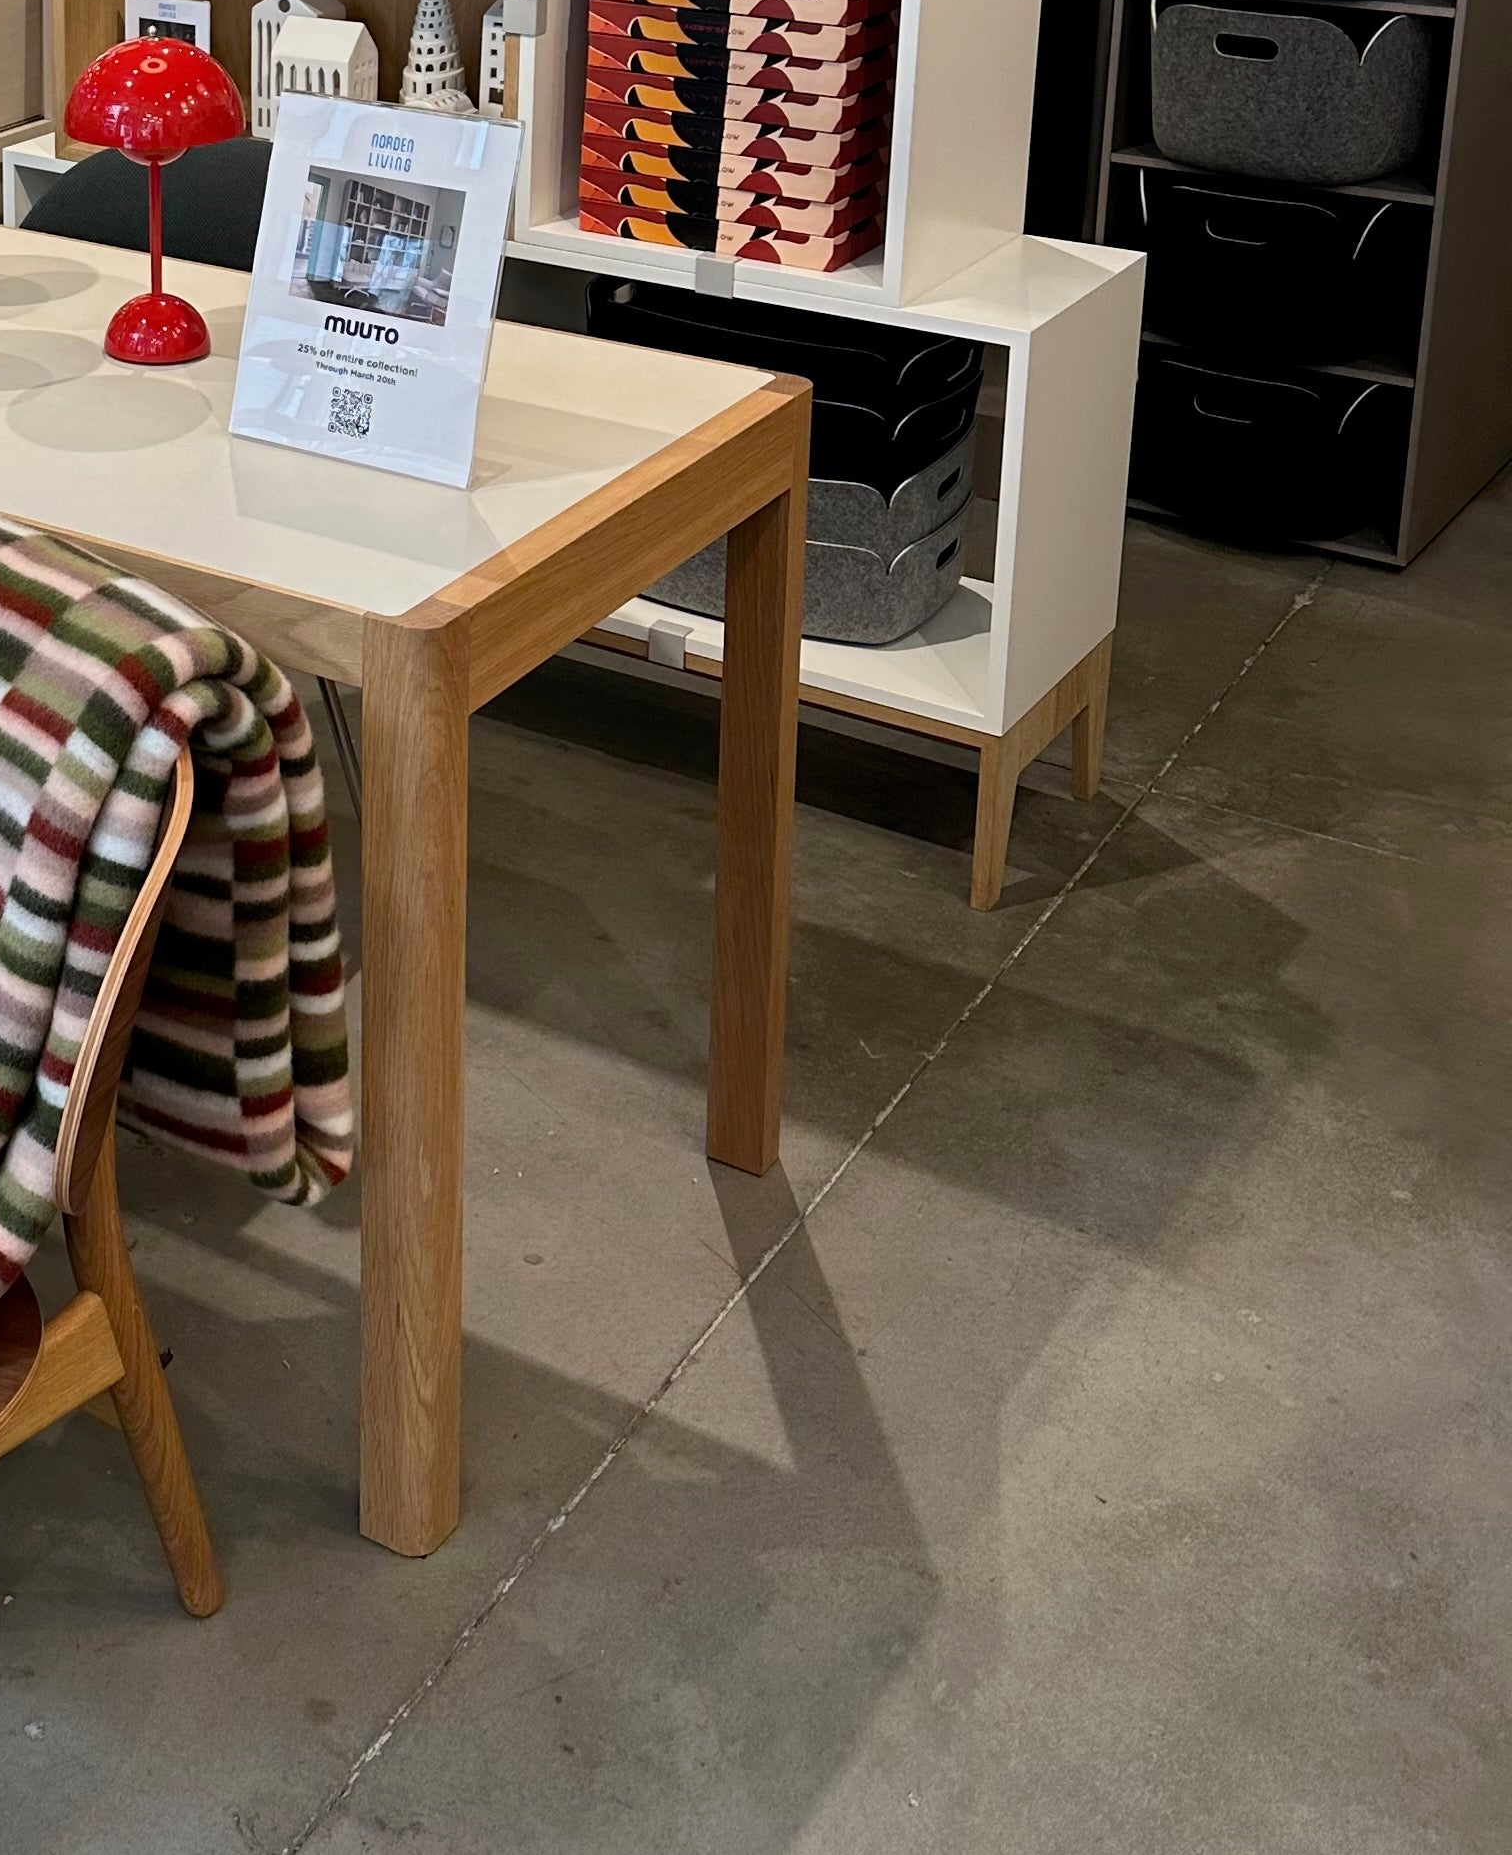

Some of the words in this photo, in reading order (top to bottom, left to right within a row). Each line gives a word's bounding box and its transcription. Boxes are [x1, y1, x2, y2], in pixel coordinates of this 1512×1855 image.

[370, 133, 415, 154] NORDEN
[368, 151, 413, 173] LIVING
[324, 315, 399, 344] MUUTO
[297, 343, 318, 356] 25%
[319, 348, 335, 359] off
[336, 353, 364, 365] entire
[367, 359, 418, 378] collection!
[315, 361, 349, 377] Through
[350, 368, 375, 382] March
[376, 374, 397, 386] 20th
